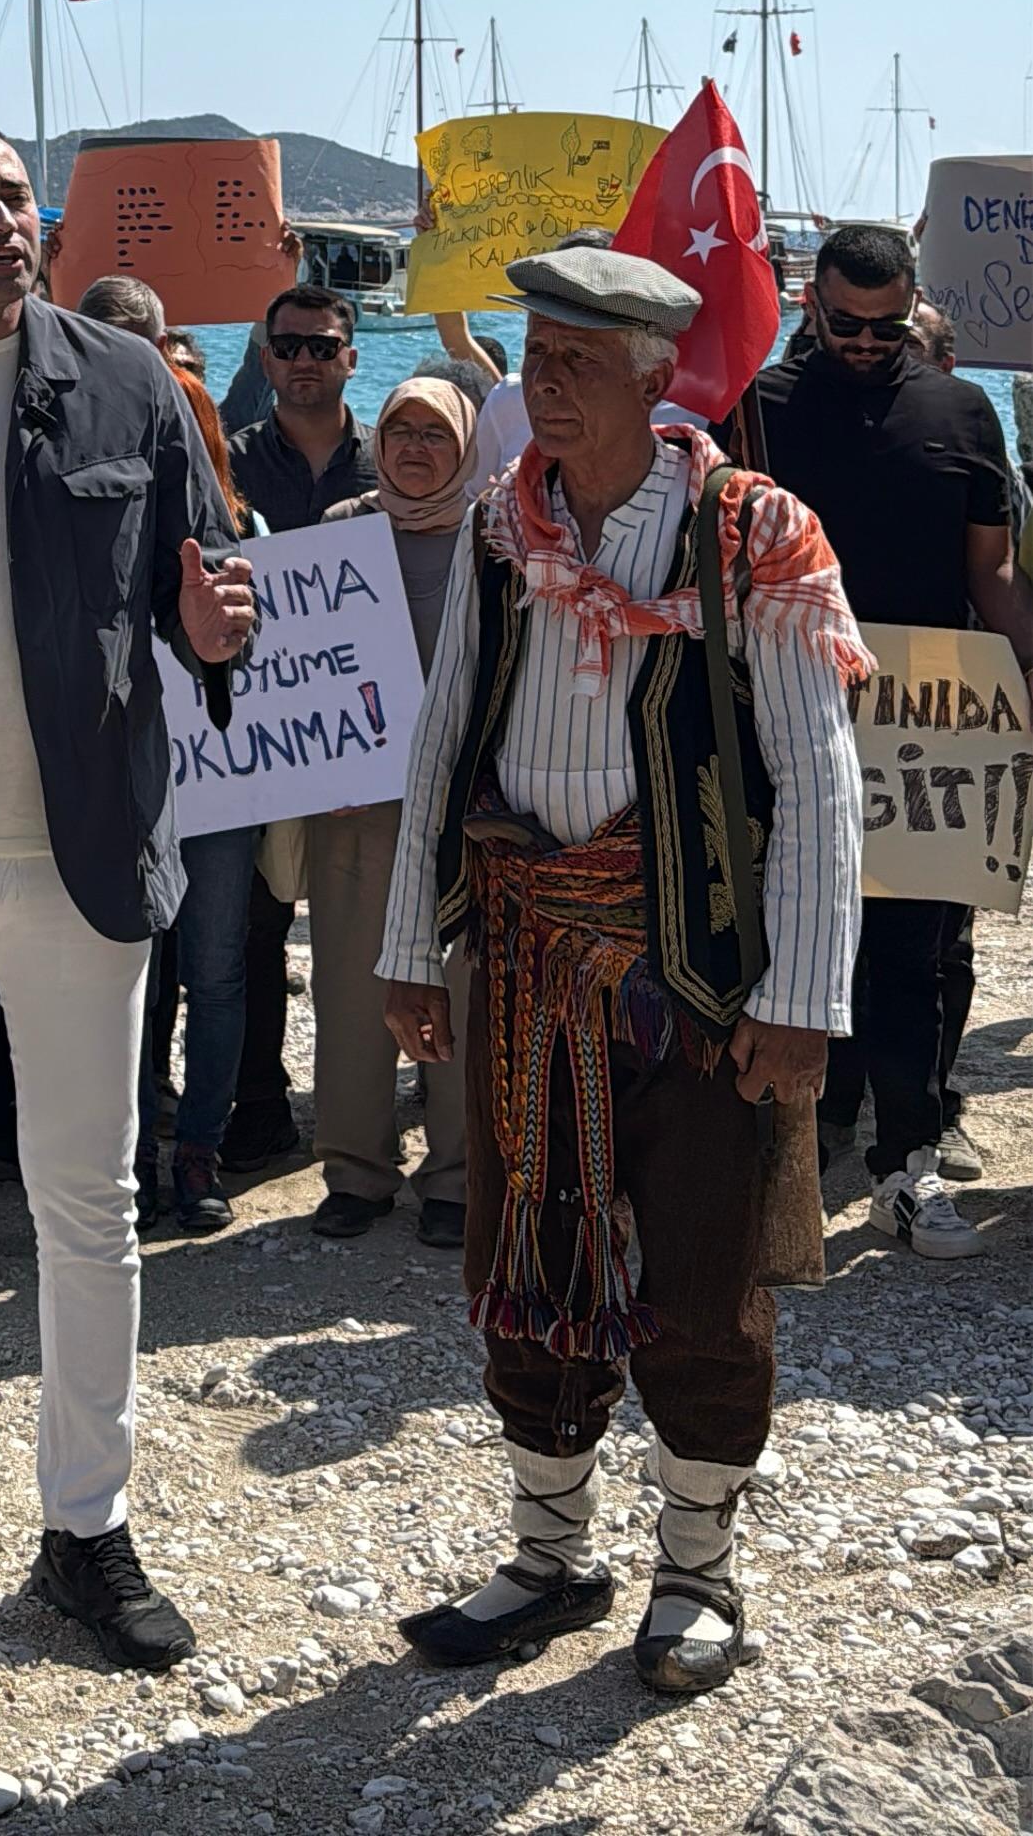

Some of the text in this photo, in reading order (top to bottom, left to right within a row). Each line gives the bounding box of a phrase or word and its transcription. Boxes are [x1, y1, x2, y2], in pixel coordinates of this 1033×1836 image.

[979, 260, 1033, 328] Se
[257, 559, 380, 621] NIMA
[171, 680, 387, 787] OKUNMA!
[846, 674, 1023, 734] TINIDA
